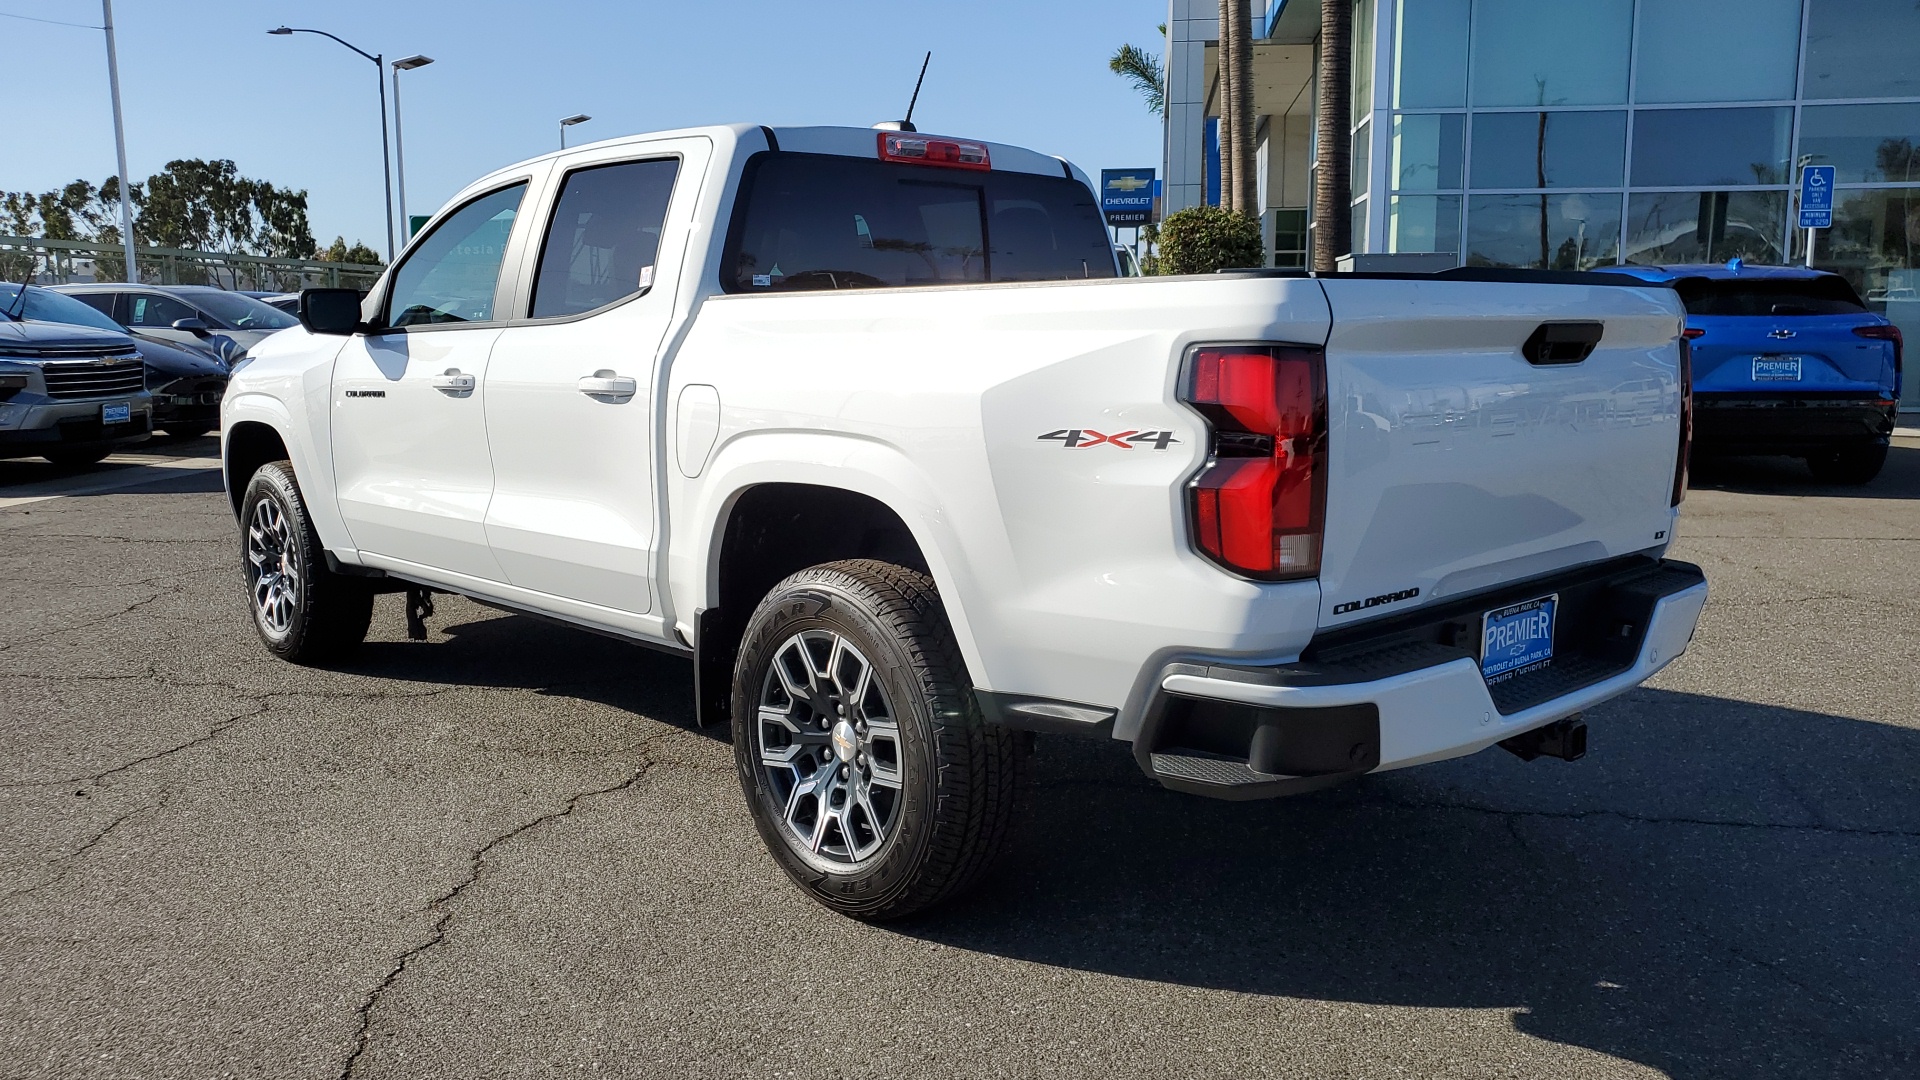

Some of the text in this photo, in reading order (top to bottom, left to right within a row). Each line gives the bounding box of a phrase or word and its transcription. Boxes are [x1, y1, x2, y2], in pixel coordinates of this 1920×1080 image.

[1105, 197, 1151, 205] CHEVROLET
[1801, 218, 1812, 226] FINE
[1756, 361, 1798, 372] PREMIER
[1654, 530, 1666, 540] LT
[1333, 587, 1420, 615] COLORADO
[1503, 605, 1520, 617] BUENA
[1533, 600, 1540, 609] CA
[1485, 611, 1549, 657] PREMIER
[1508, 659, 1514, 667] of
[1514, 654, 1530, 666] BUENA
[1544, 647, 1551, 656] CA
